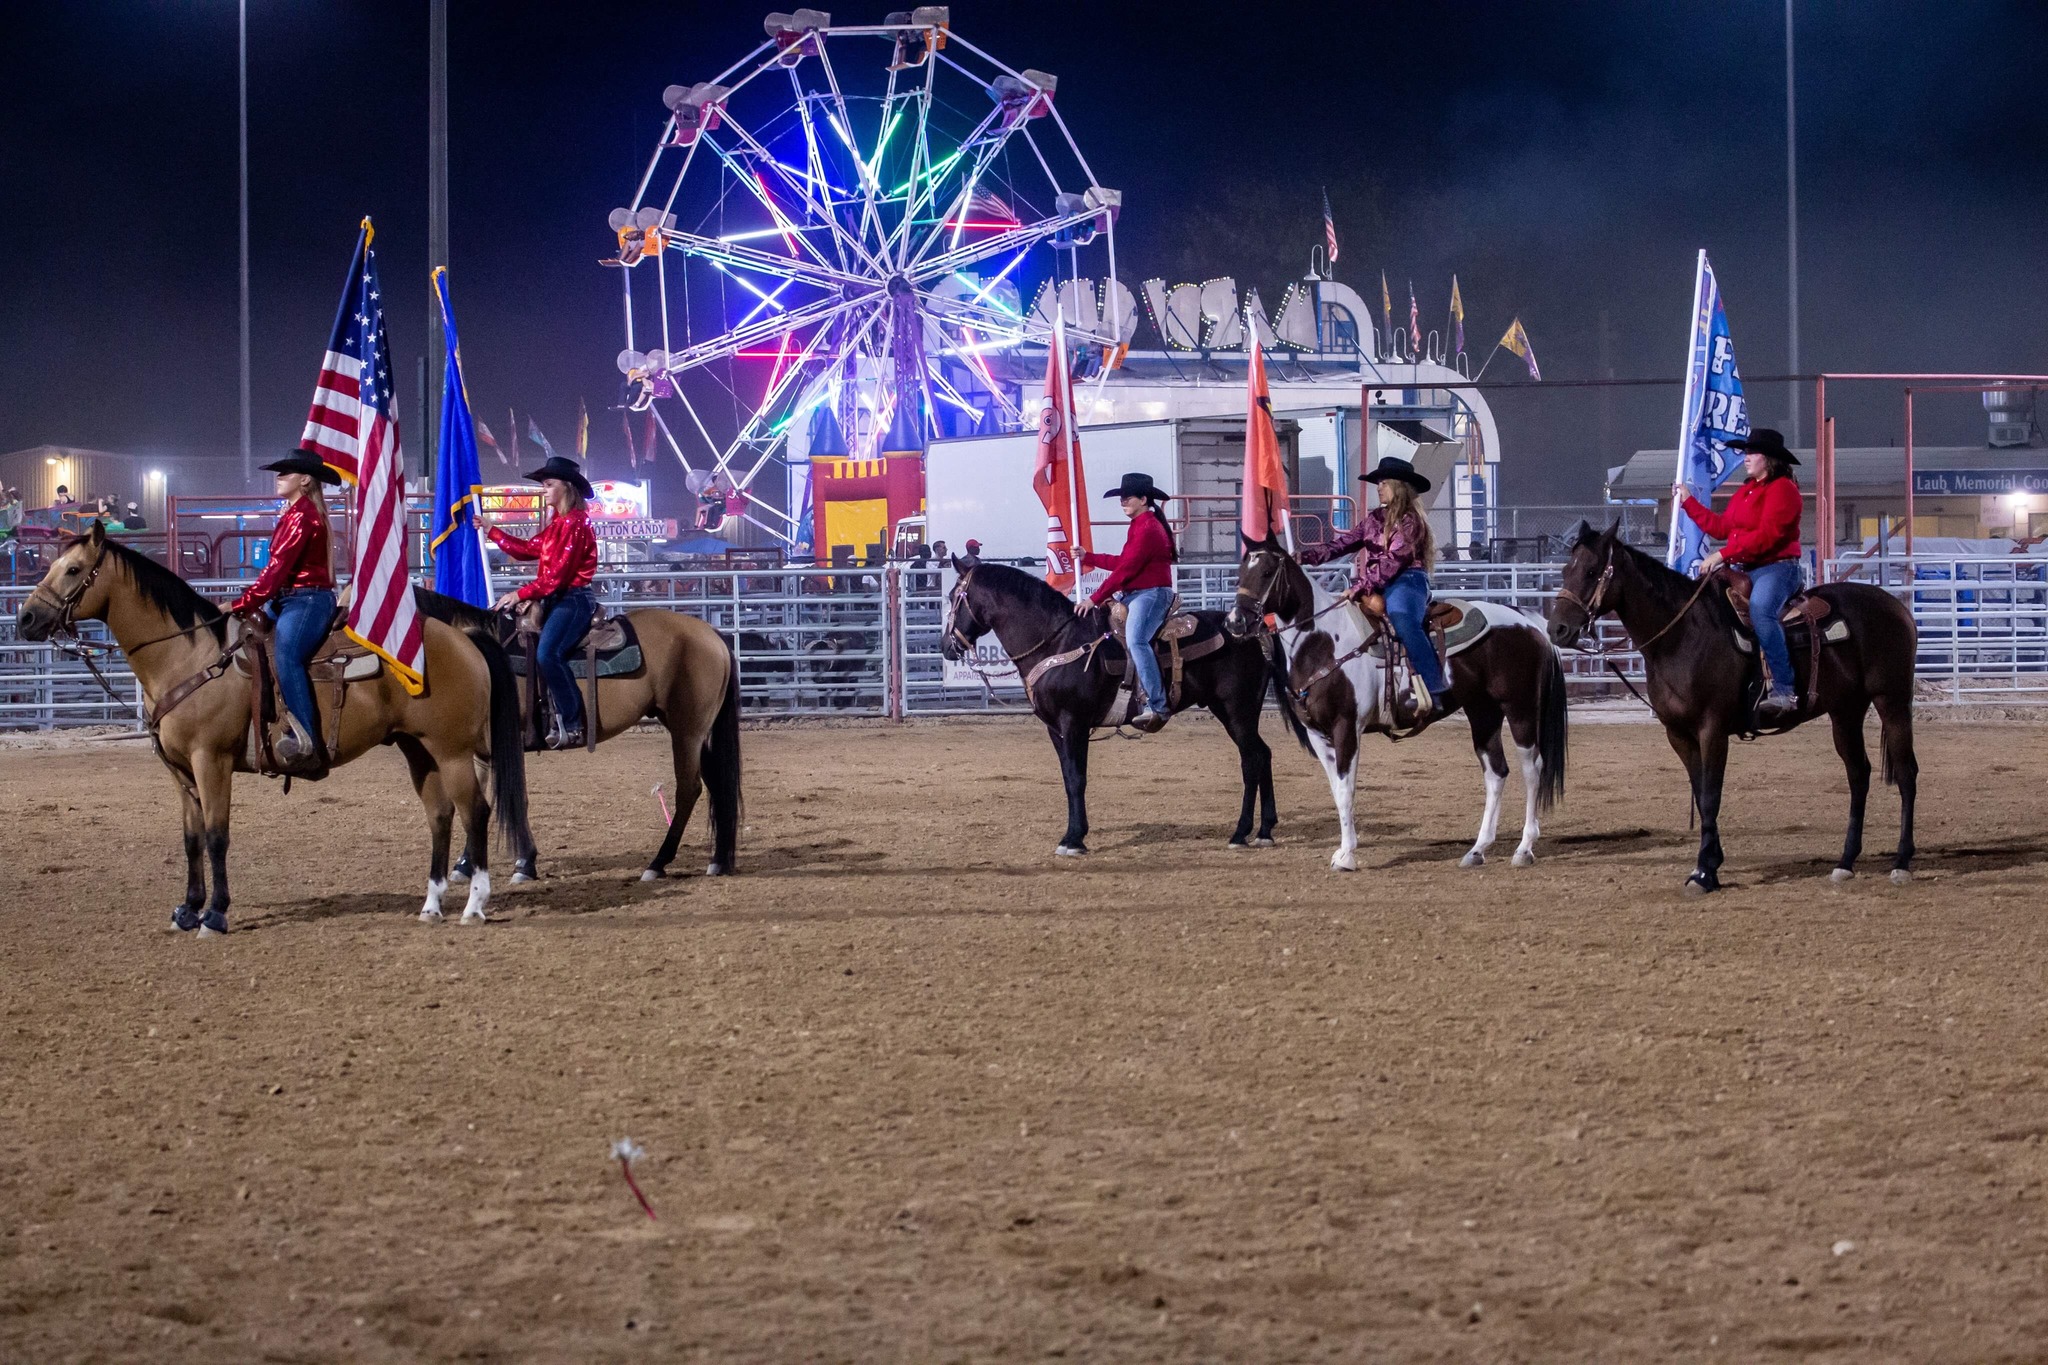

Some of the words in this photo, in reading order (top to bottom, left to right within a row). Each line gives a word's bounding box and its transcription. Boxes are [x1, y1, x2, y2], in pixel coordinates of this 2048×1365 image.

[1916, 475, 1948, 490] Laub
[1955, 474, 2016, 490] Memorial
[2023, 474, 2048, 489] Coo
[587, 502, 636, 514] ANDY
[594, 525, 629, 536] OTTON
[631, 524, 665, 535] CANDY
[953, 671, 981, 680] APPARE
